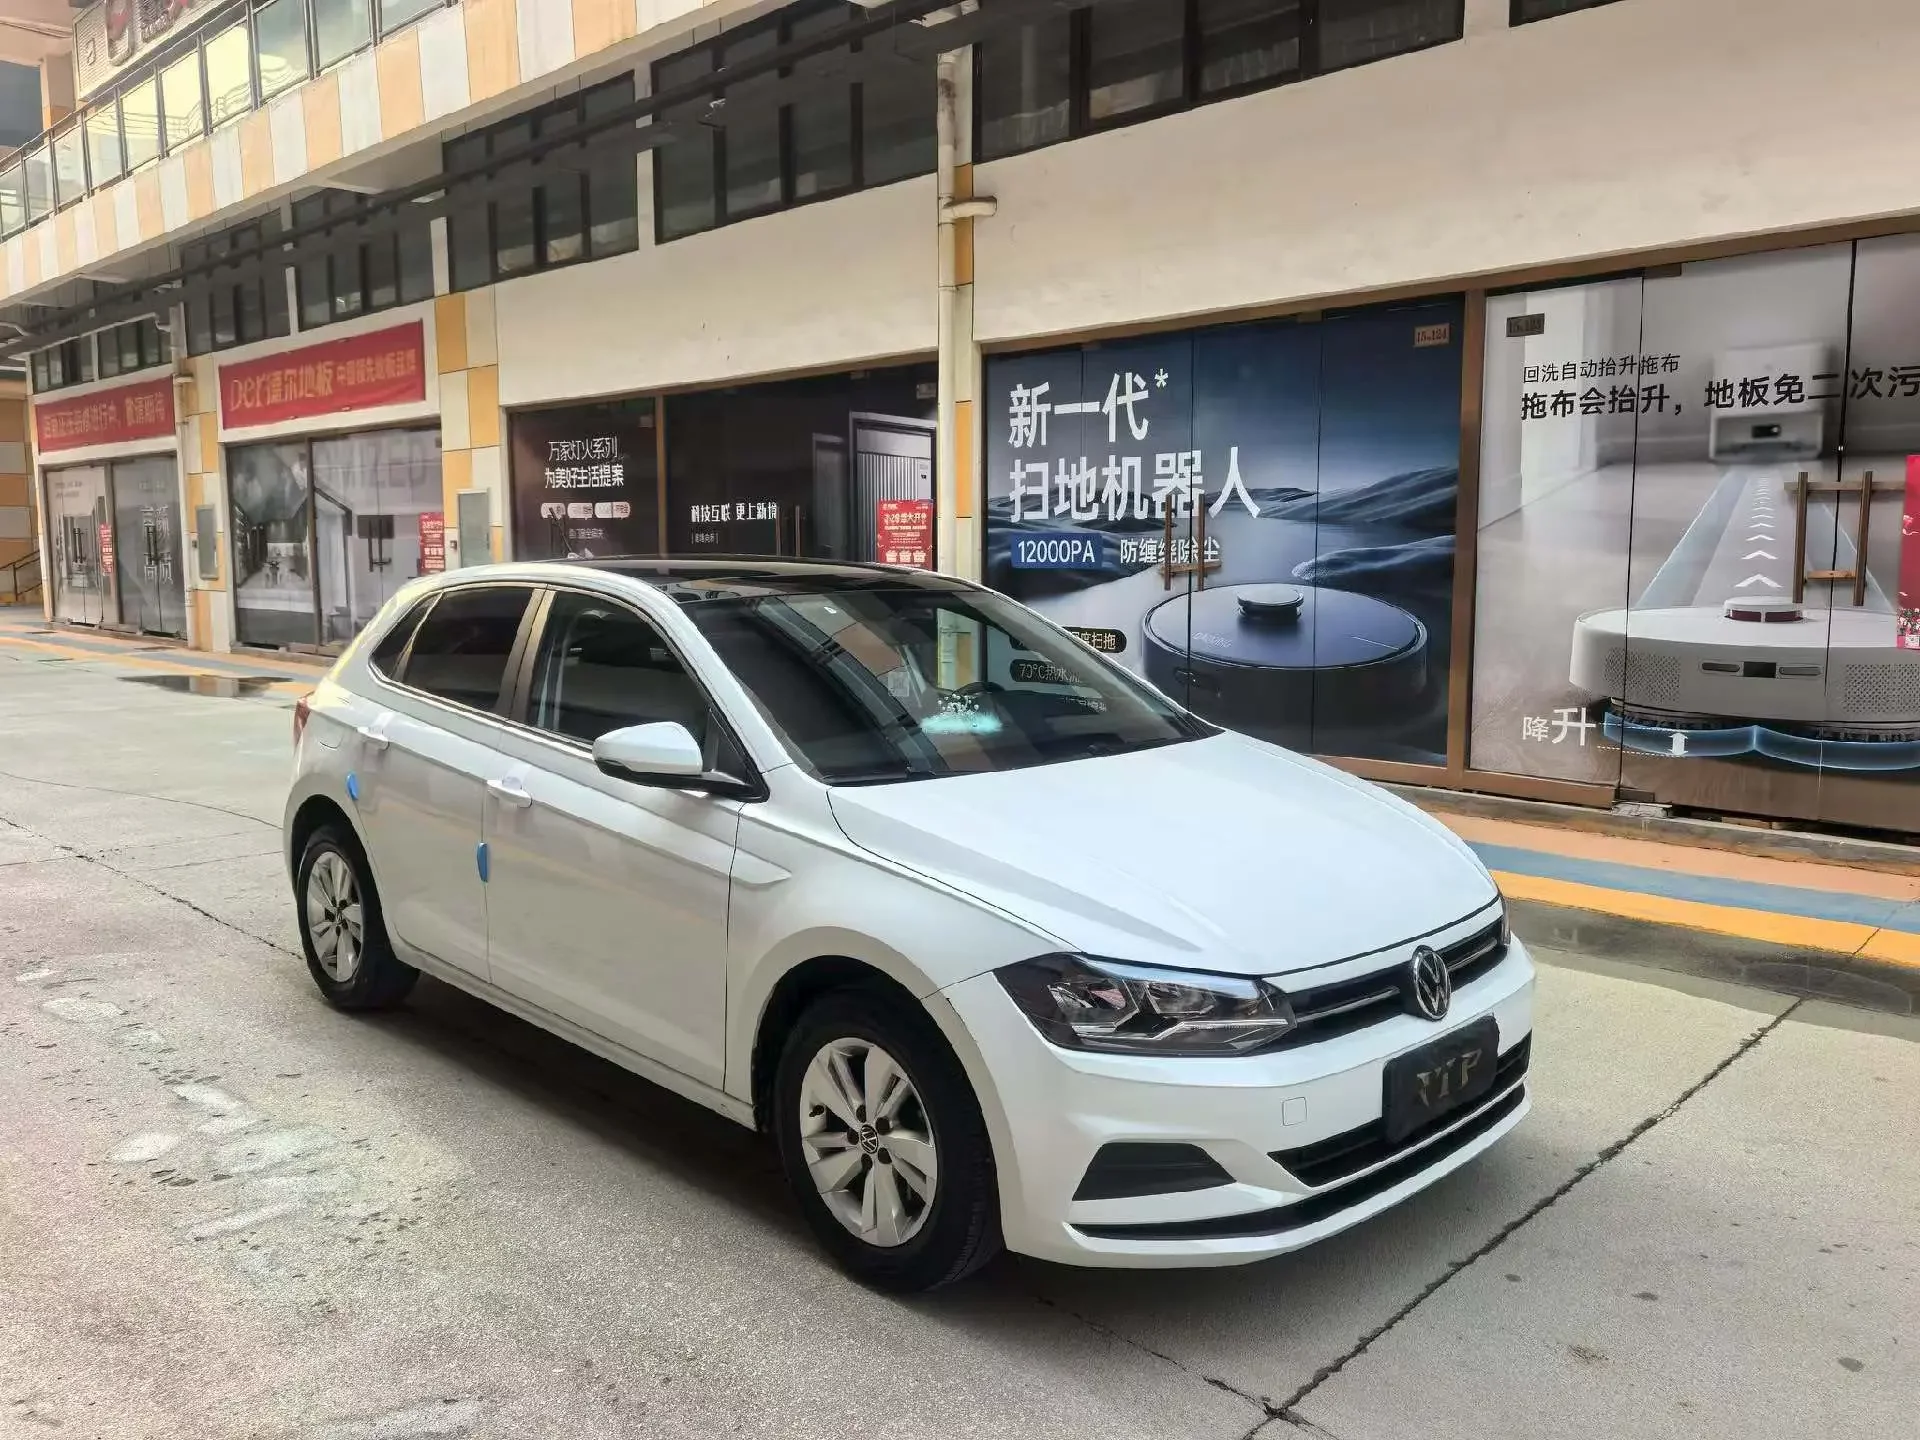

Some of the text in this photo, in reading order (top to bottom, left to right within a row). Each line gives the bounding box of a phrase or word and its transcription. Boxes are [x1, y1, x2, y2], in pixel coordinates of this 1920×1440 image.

[1523, 353, 1681, 383] 回洗自动抬升拖布
[547, 435, 618, 461] 万家灯火系列
[544, 464, 625, 489] 为美好生活提案
[1009, 446, 1261, 523] 扫地机器人
[691, 501, 778, 523] 科技互联 更上新境
[1017, 538, 1096, 564] 12000PA
[1119, 535, 1221, 565] 防缠绕除尘
